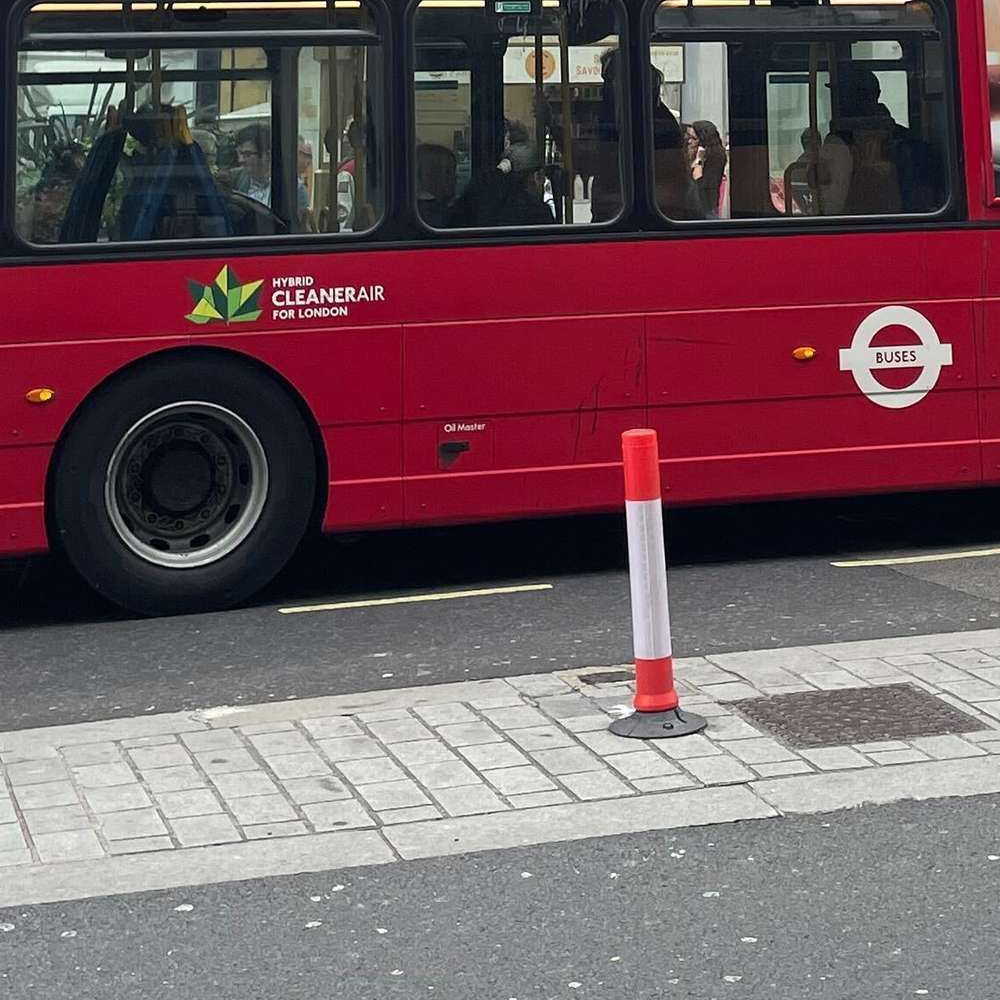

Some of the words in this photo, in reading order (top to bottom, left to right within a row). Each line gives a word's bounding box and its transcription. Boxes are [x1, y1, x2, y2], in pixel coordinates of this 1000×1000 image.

[272, 276, 314, 288] HYBRID
[272, 286, 385, 307] CLEANERAIR
[272, 309, 296, 320] FOR
[298, 307, 348, 319] LONDON
[875, 350, 917, 365] BUSES
[444, 423, 457, 432] Oil
[457, 423, 486, 432] Master
